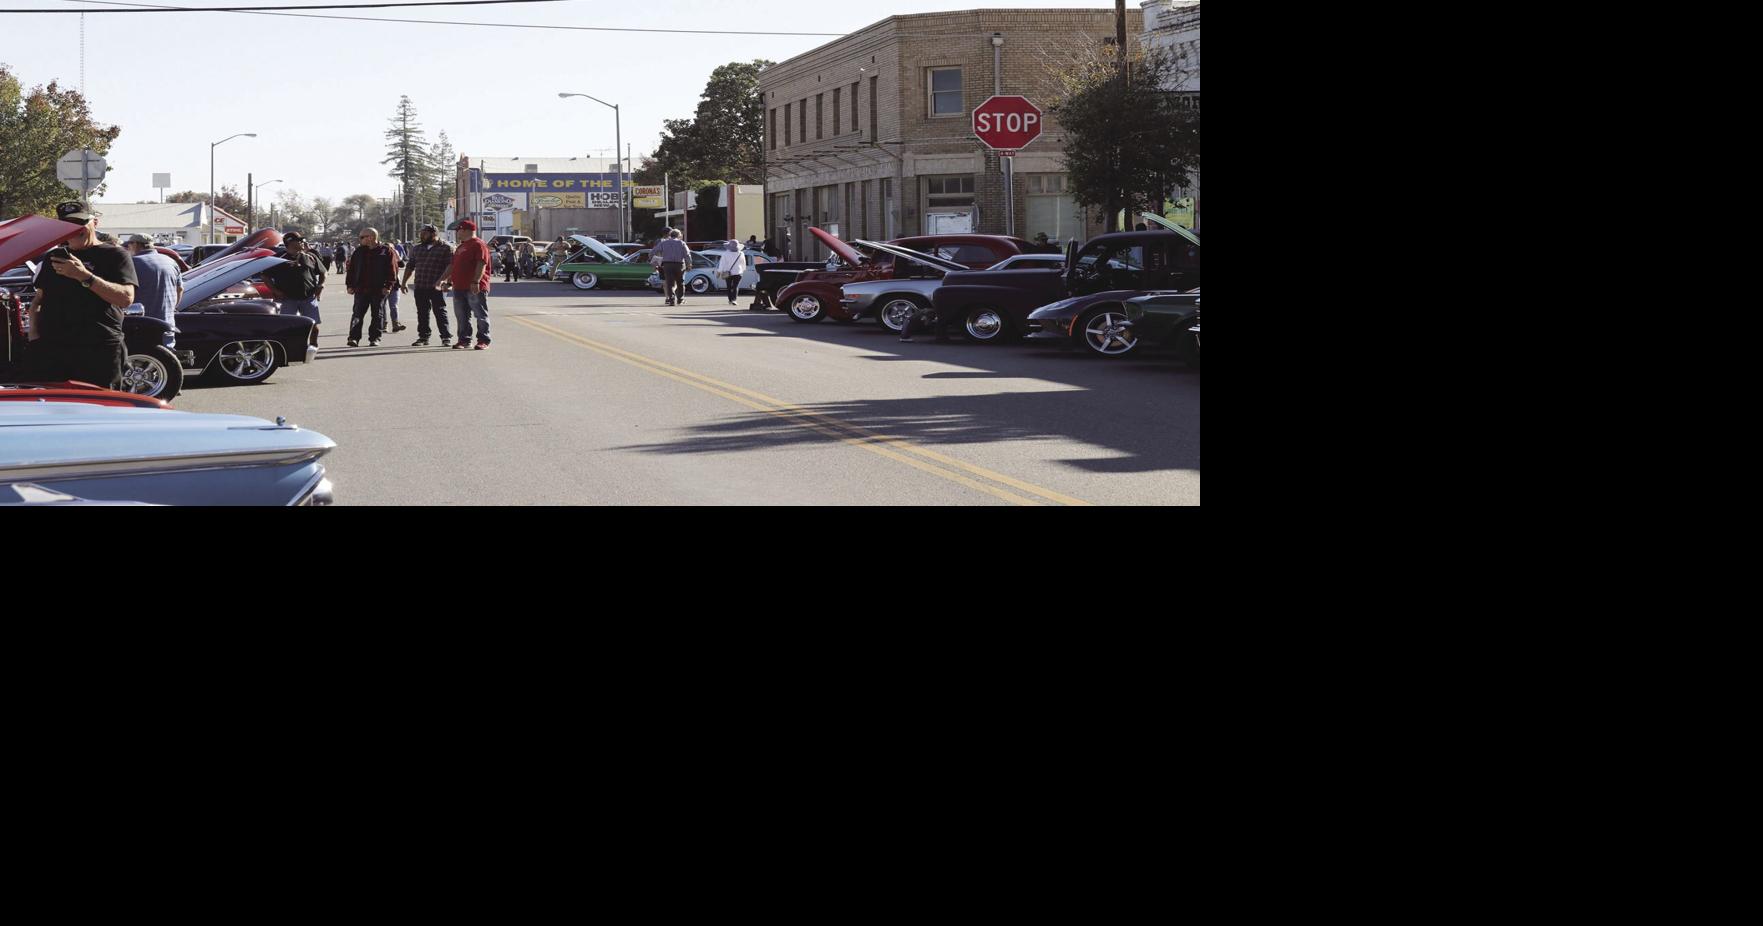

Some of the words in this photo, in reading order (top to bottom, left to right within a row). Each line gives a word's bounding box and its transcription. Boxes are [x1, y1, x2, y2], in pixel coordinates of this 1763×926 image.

[976, 112, 1038, 133] STOP
[497, 179, 547, 188] HOME
[552, 179, 575, 188] OF
[579, 179, 613, 188] THE
